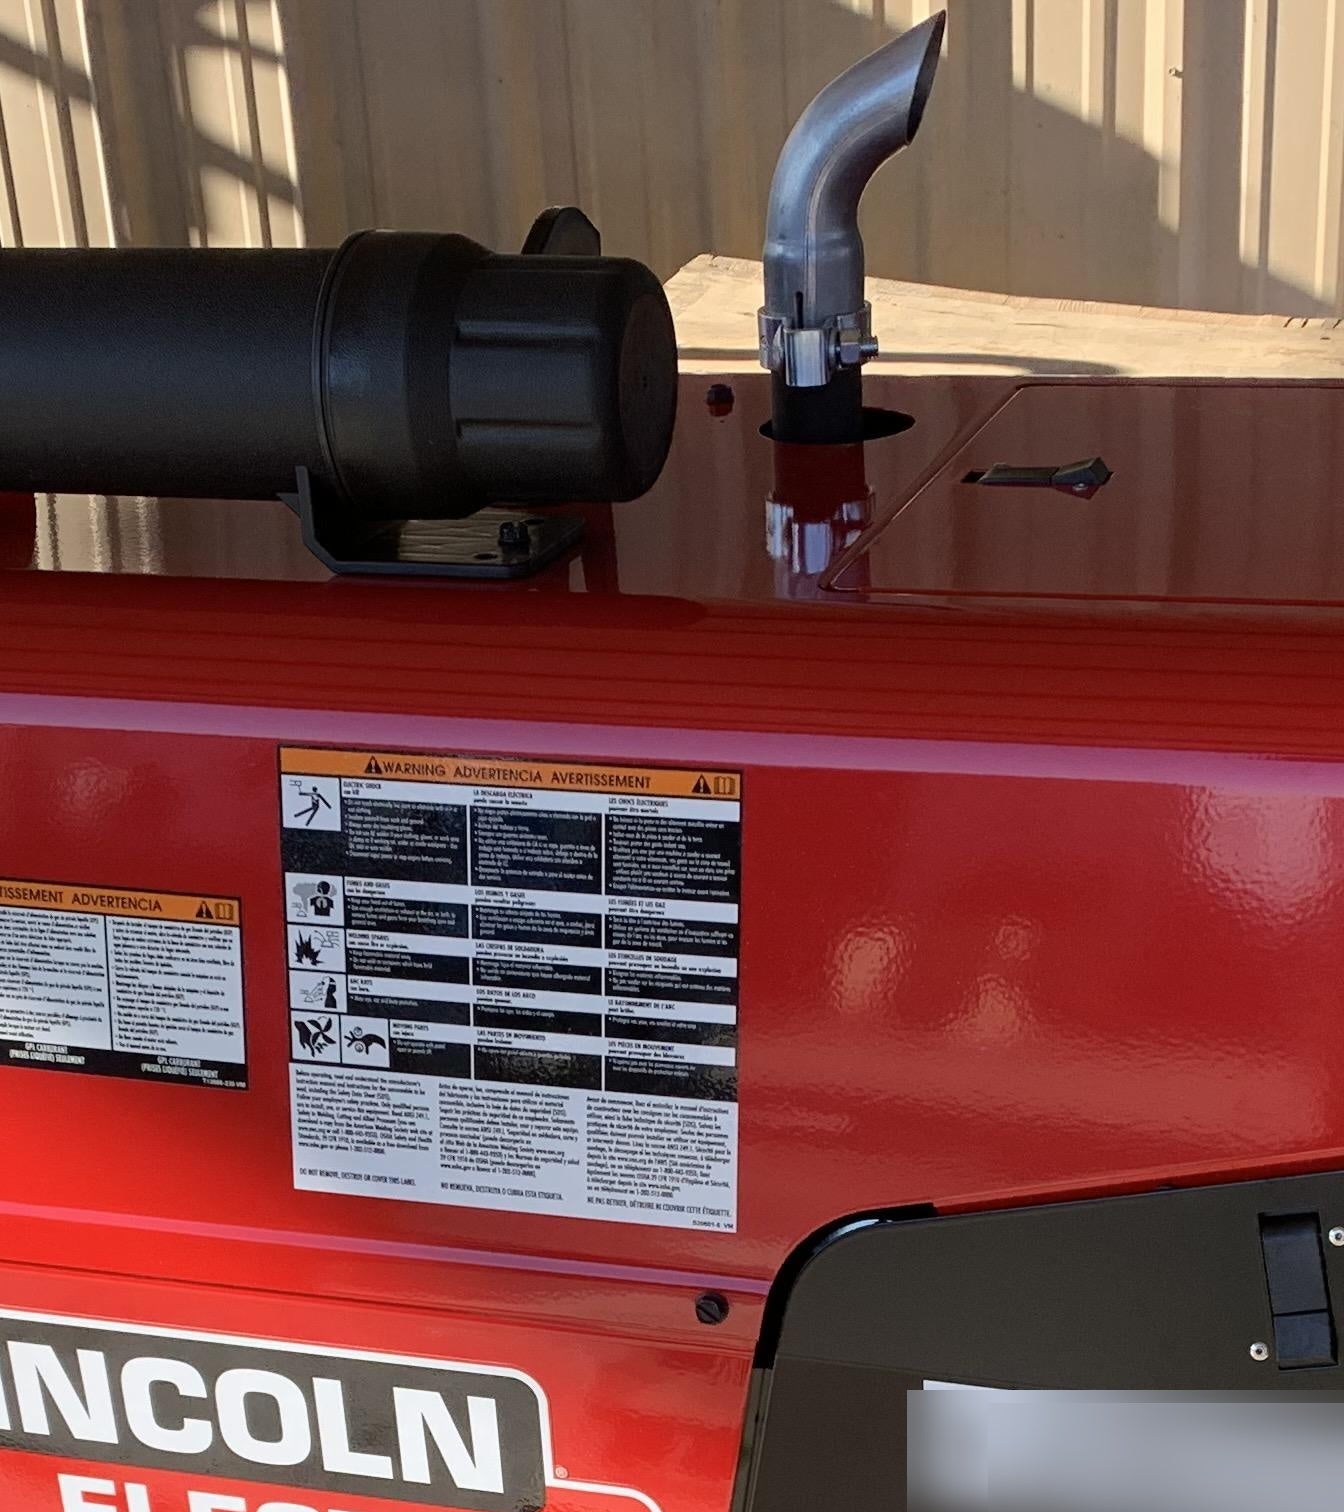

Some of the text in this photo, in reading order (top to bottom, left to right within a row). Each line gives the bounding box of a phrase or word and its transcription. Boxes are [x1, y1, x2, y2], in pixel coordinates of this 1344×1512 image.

[382, 761, 650, 788] WARNING ADVERTENCIA AVERTISSEMENT
[71, 891, 162, 911] ADVERTENCIA
